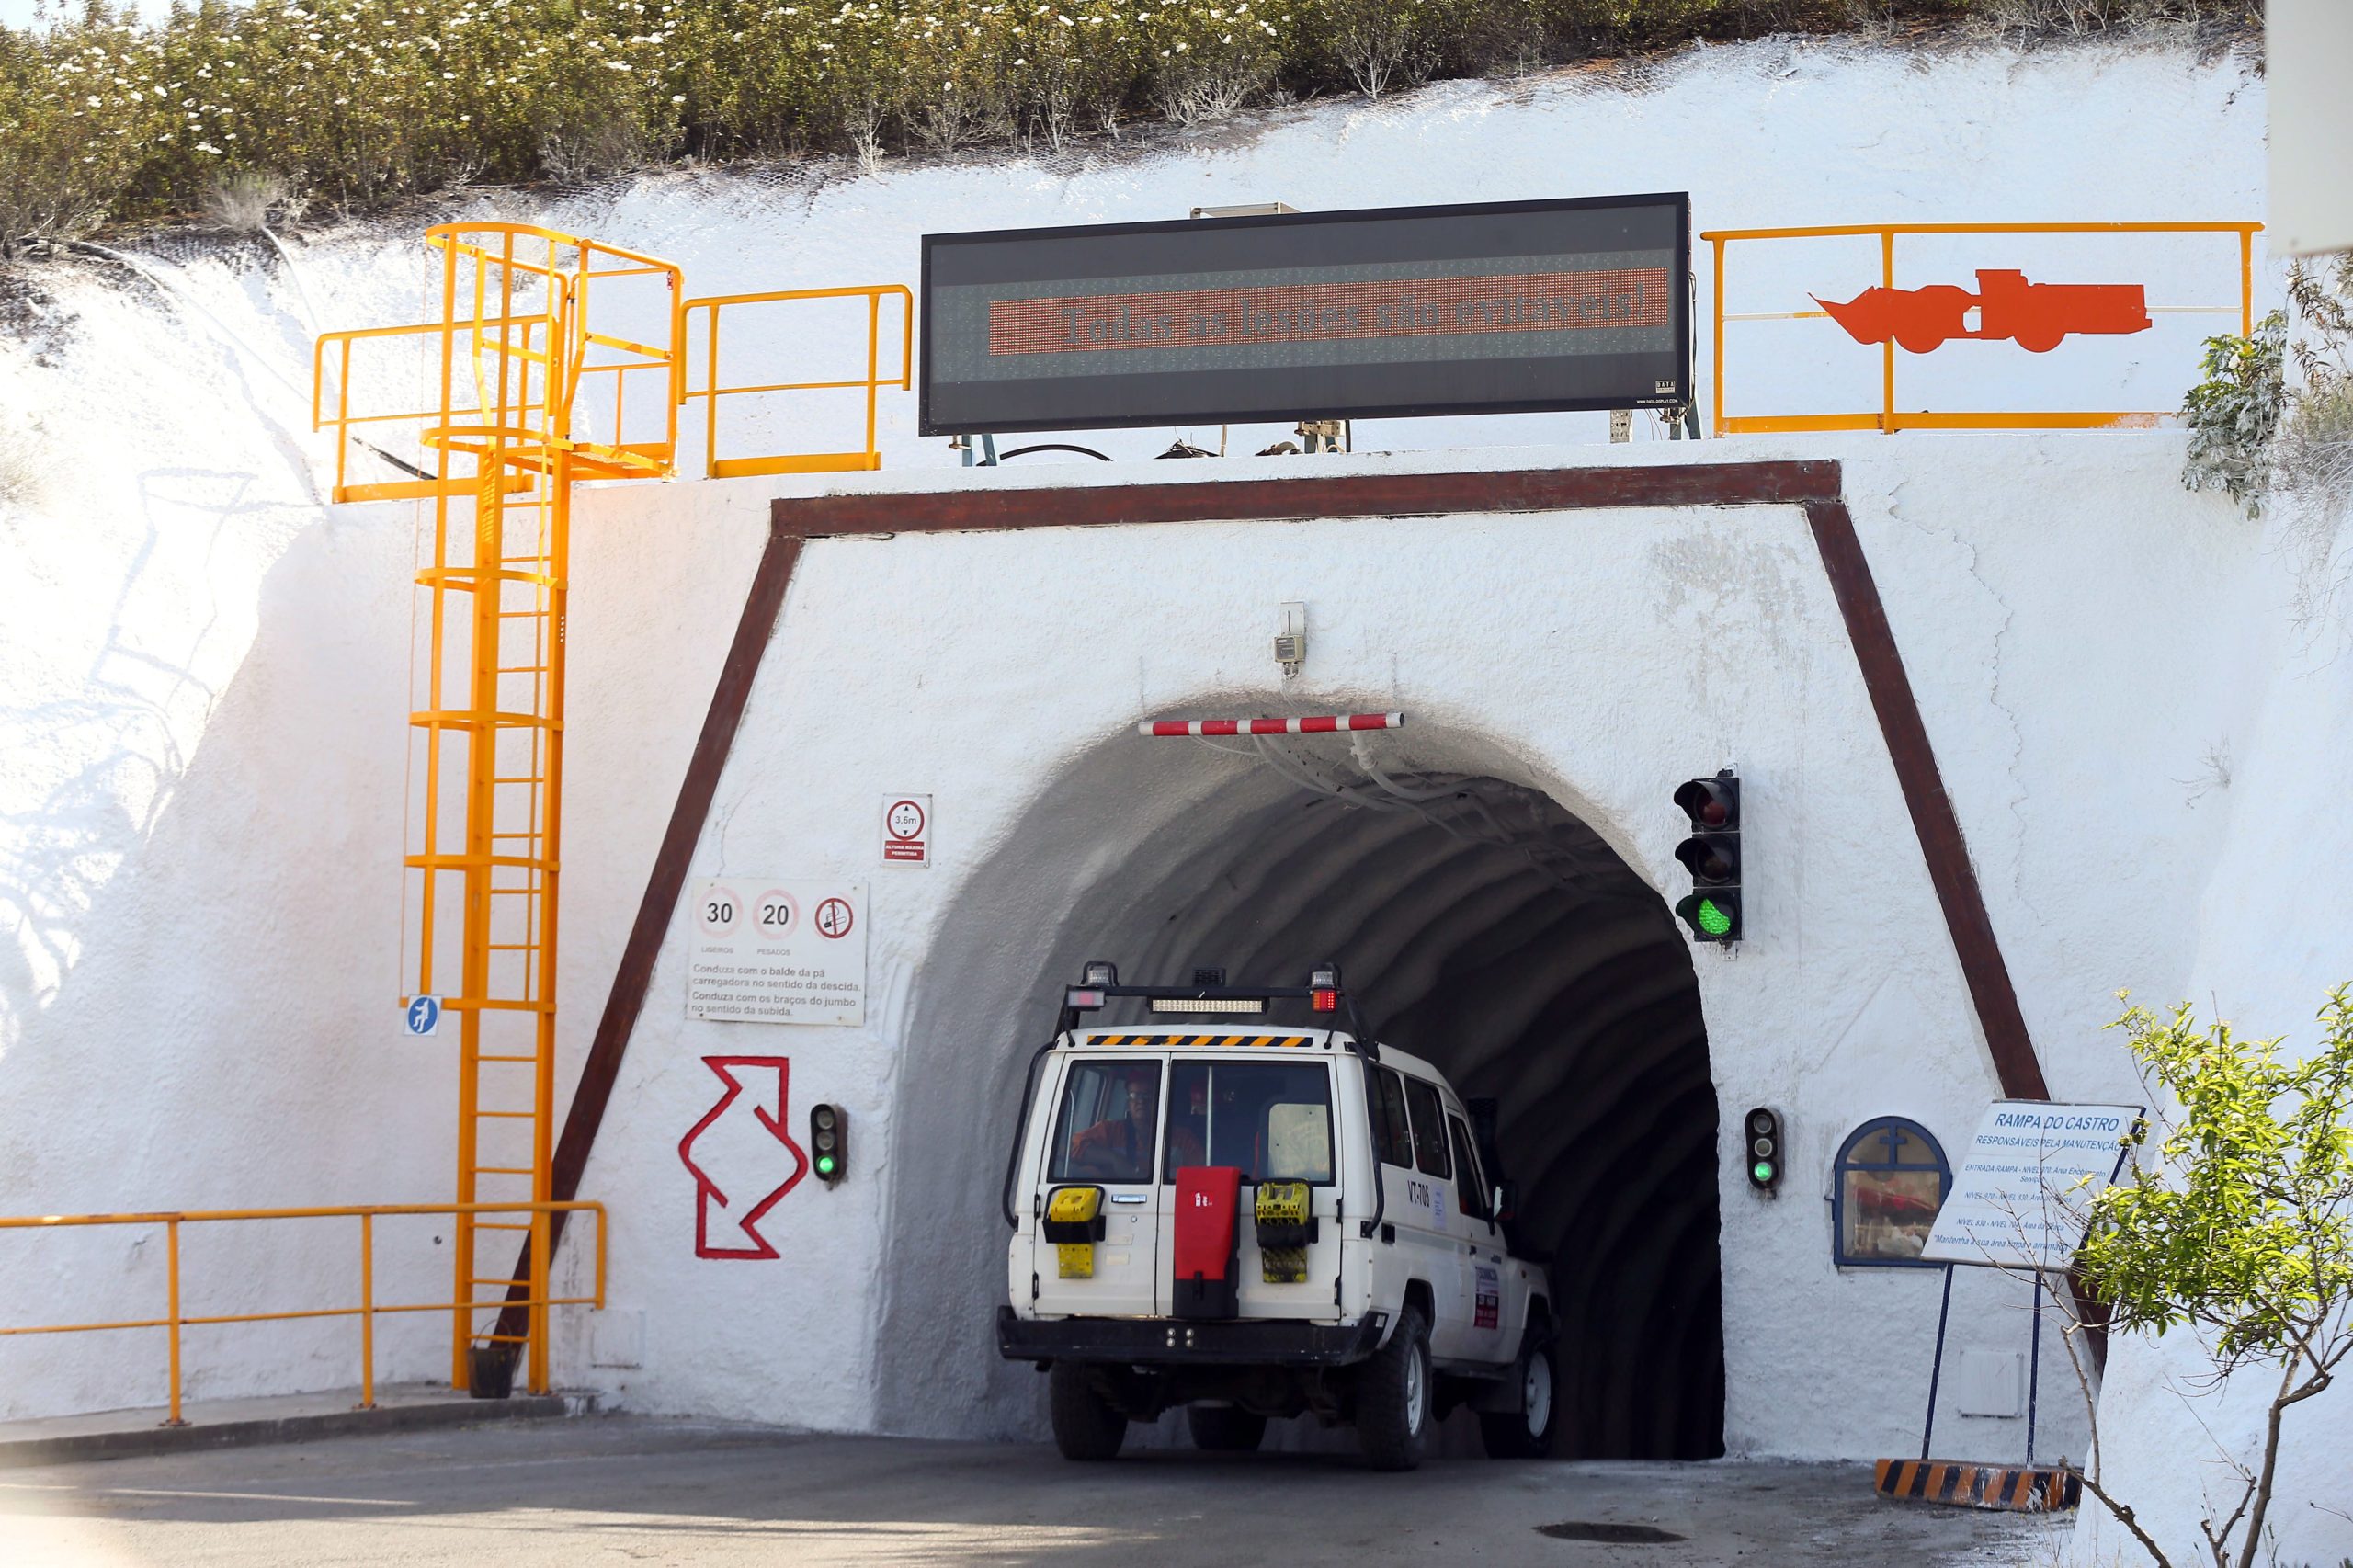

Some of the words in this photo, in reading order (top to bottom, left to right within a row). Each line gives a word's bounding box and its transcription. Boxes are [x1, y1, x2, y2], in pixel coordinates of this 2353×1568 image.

[1062, 305, 1172, 345] Todas
[1189, 311, 1227, 337] as
[1241, 298, 1359, 335] lesões
[1375, 293, 1438, 329] são
[1455, 281, 1644, 324] evitáveis!
[895, 815, 916, 824] 3,6m
[707, 903, 733, 923] 30
[762, 904, 790, 926] 20
[756, 948, 791, 956] PESADOS
[693, 963, 735, 974] Conduza
[737, 967, 758, 975] com
[769, 967, 796, 976] balde
[798, 968, 811, 977] da
[813, 969, 825, 979] pá
[692, 977, 750, 988] carregadora
[767, 980, 803, 989] sentido
[805, 981, 818, 990] da
[820, 982, 862, 992] descida.
[691, 991, 733, 1001] Conduza
[735, 994, 756, 1002] com
[758, 994, 771, 1003] os
[773, 995, 807, 1006] braços
[809, 996, 823, 1006] do
[824, 996, 857, 1007] jumbo
[706, 1003, 742, 1014] sentido
[743, 1005, 756, 1015] da
[757, 1006, 794, 1017] subida.
[1995, 1113, 2040, 1129] RAMPA
[2043, 1115, 2064, 1130] DO
[2065, 1116, 2120, 1131] CASTRO
[1975, 1134, 2040, 1148] RESPONSÁVEIS
[2040, 1138, 2060, 1148] PELA
[2062, 1139, 2121, 1153] MANUTENÇÃO
[1965, 1164, 1995, 1173] ENTRADA
[1995, 1165, 2018, 1173] RAMPA
[1407, 1179, 1429, 1208] VT-705
